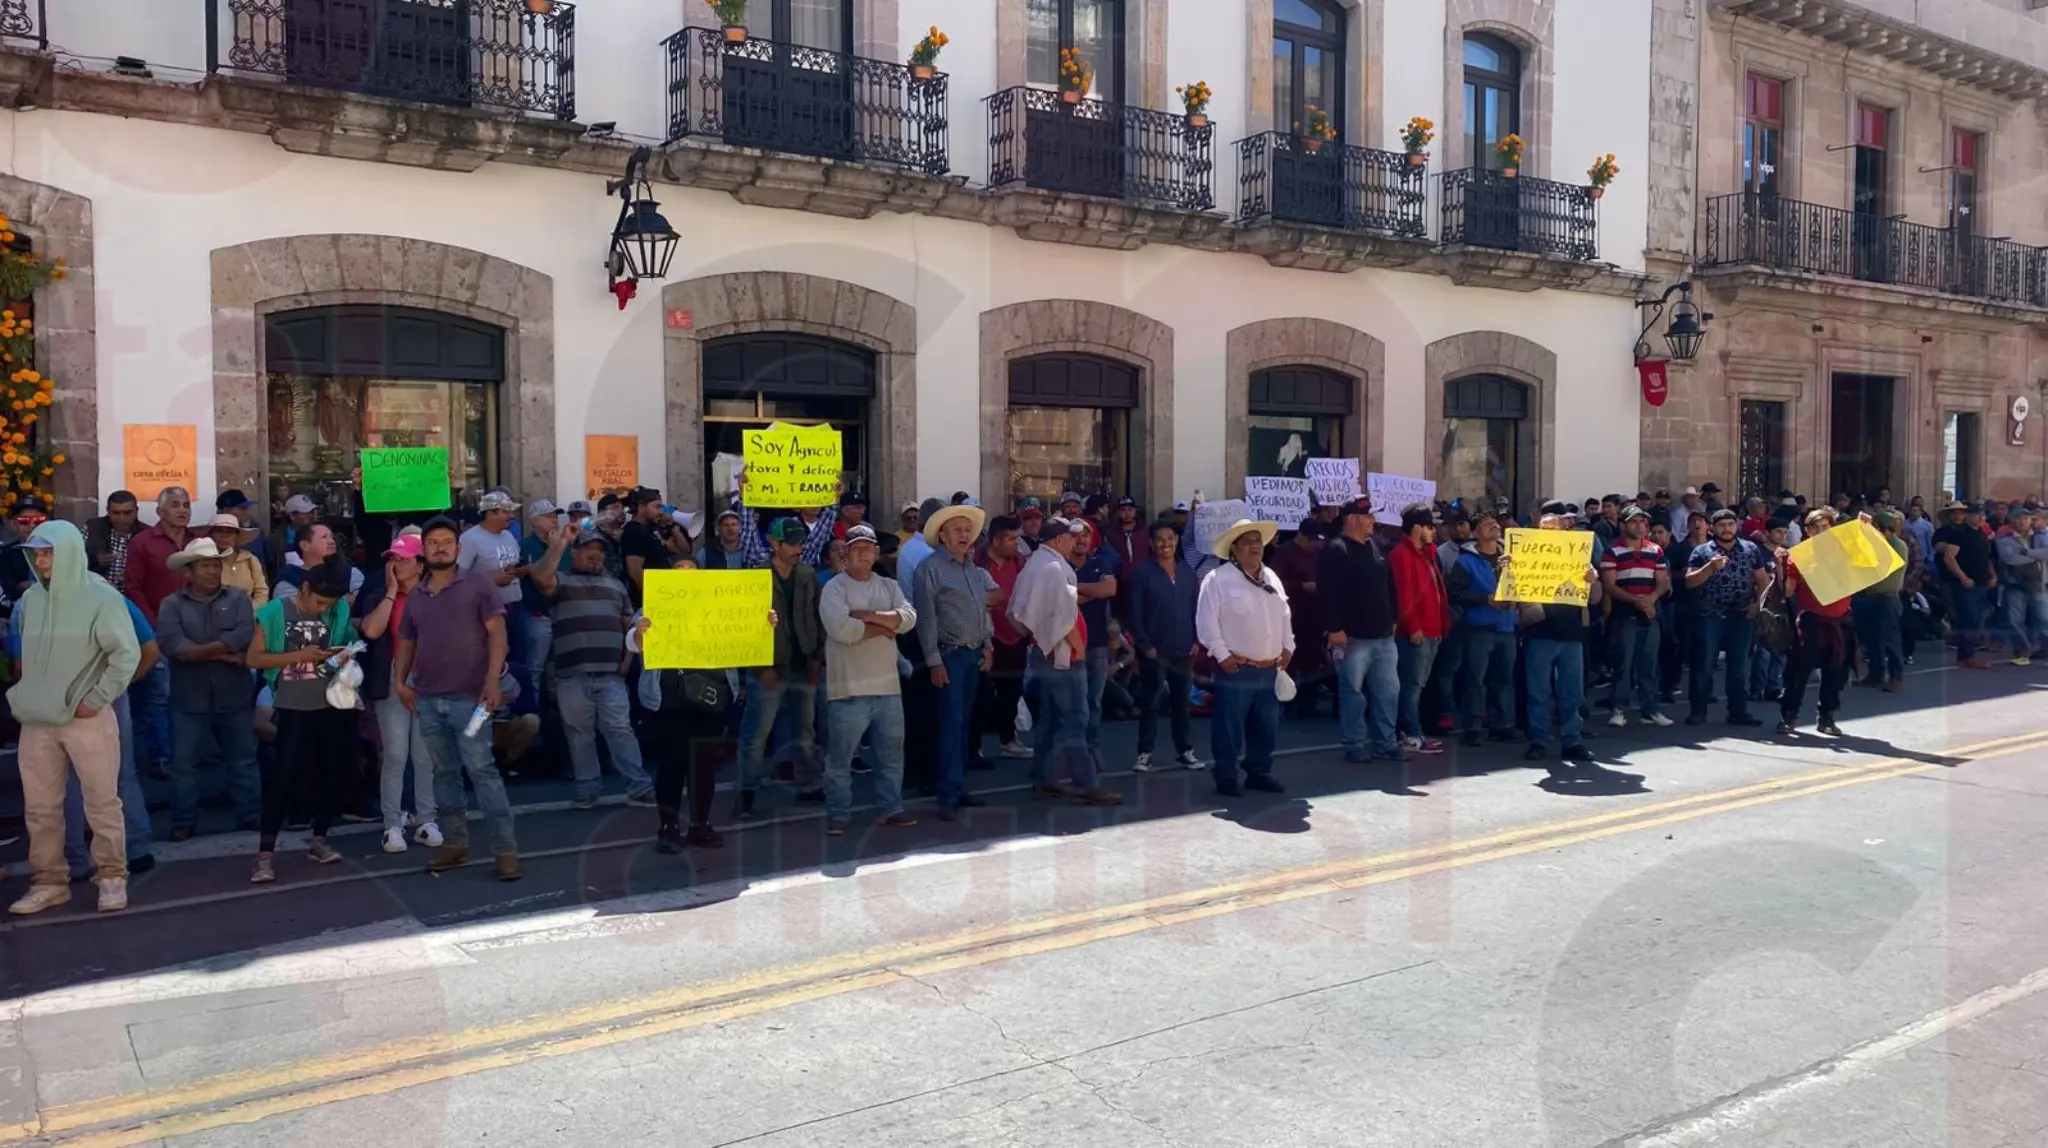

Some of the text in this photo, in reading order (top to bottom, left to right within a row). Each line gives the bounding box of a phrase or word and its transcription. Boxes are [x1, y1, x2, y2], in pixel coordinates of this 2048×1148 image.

[592, 469, 633, 477] REGALOS
[1251, 478, 1304, 493] PEDIMOS
[657, 584, 701, 600] SOY
[1506, 583, 1588, 599] MEXICANOS
